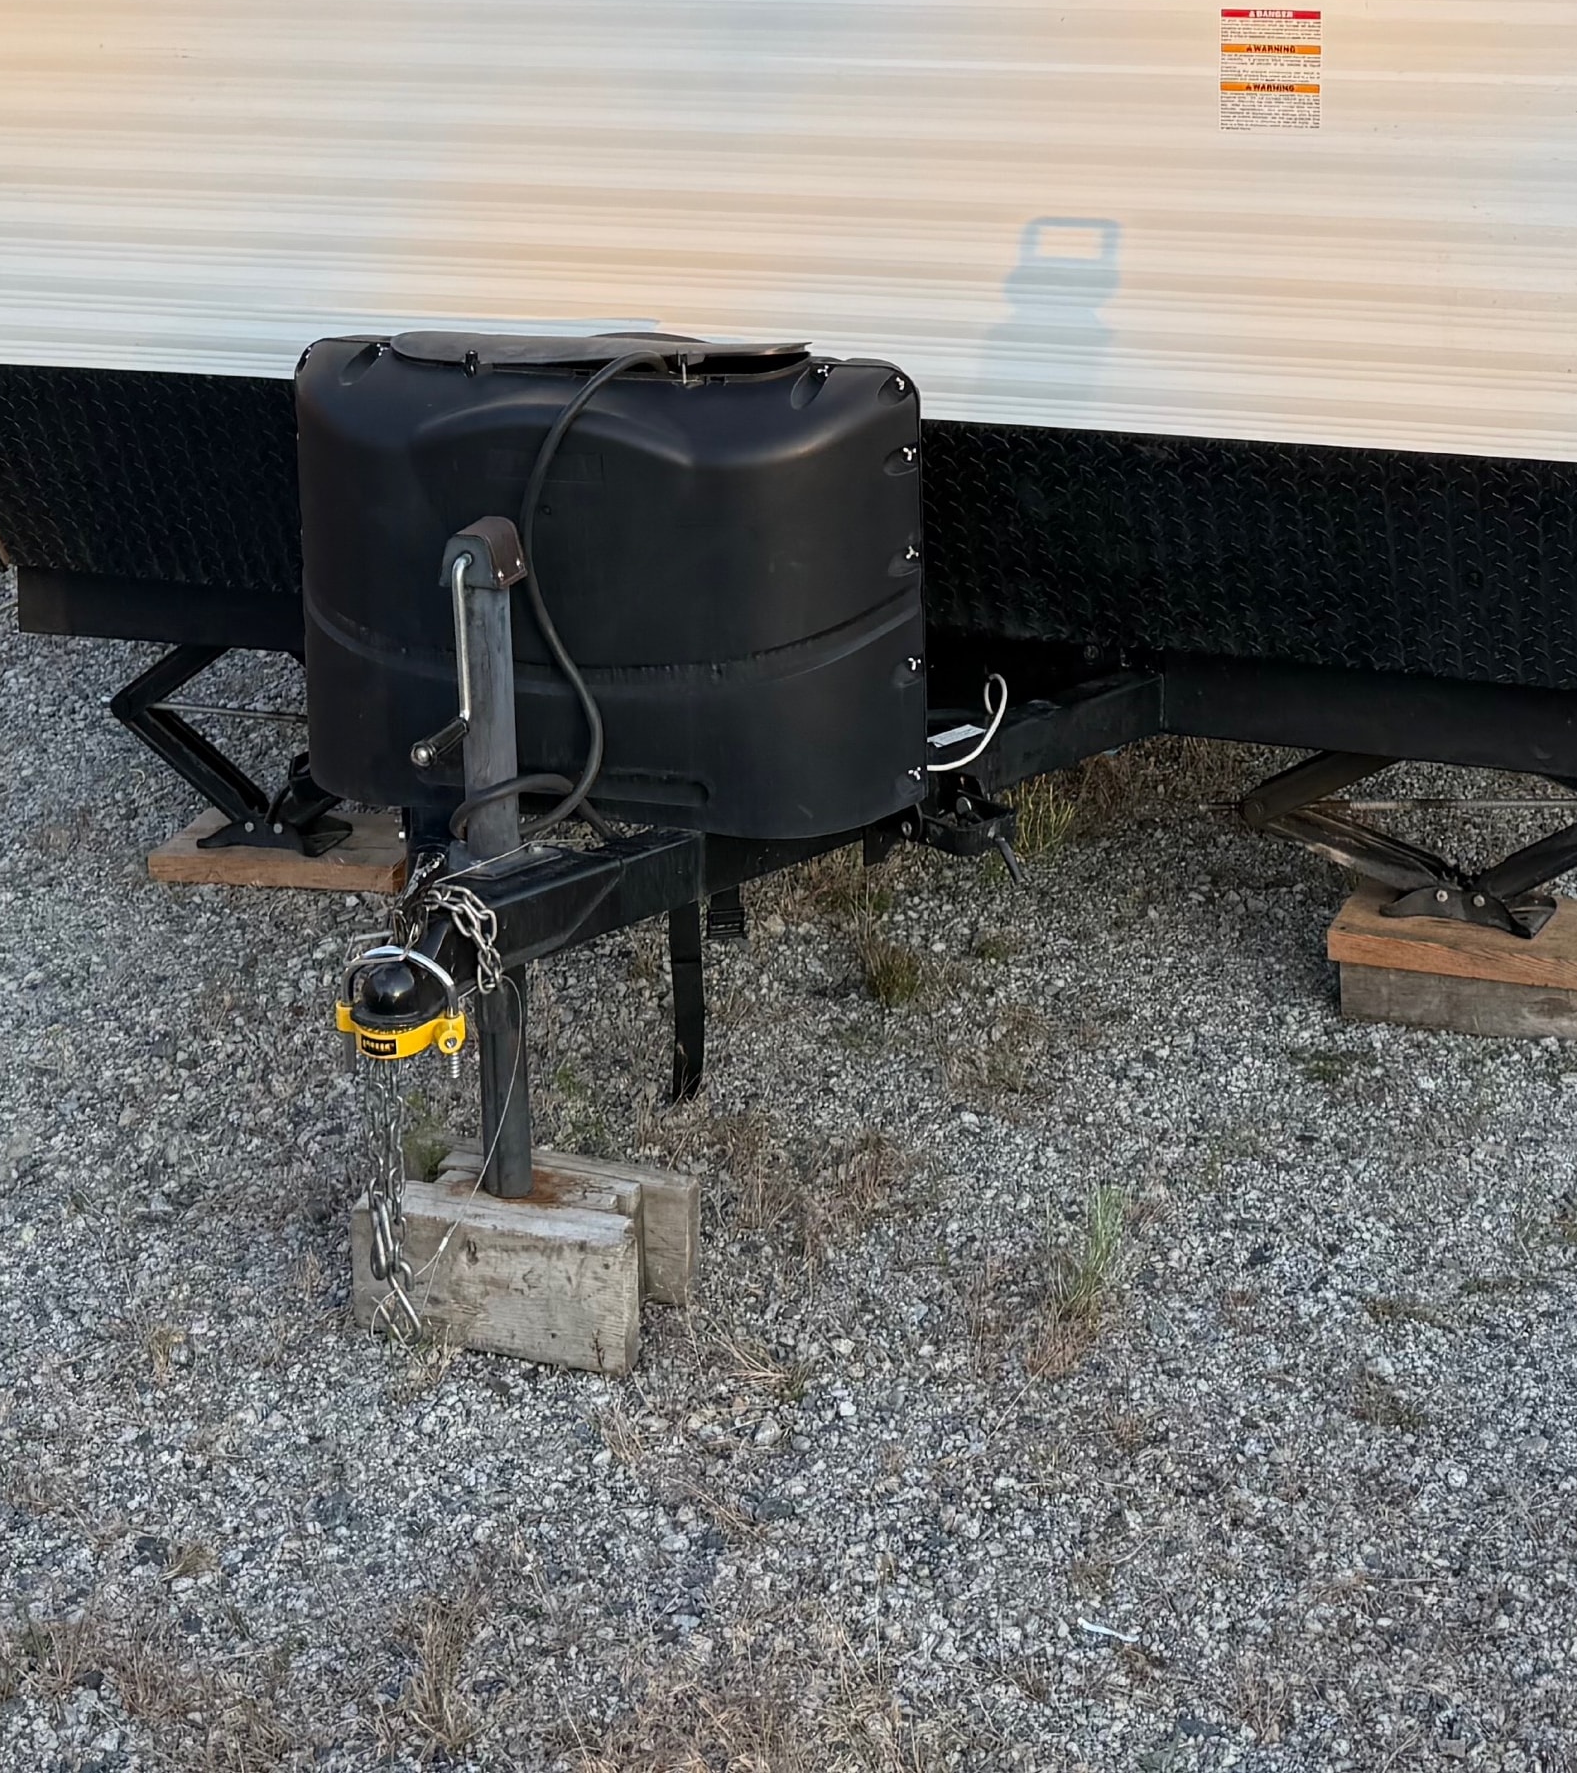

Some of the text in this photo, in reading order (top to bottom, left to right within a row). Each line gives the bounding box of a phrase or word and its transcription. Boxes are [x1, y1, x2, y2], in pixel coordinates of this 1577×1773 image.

[1256, 10, 1294, 19] DANGER
[1254, 44, 1296, 54] WARNING
[1253, 83, 1295, 93] WARNING
